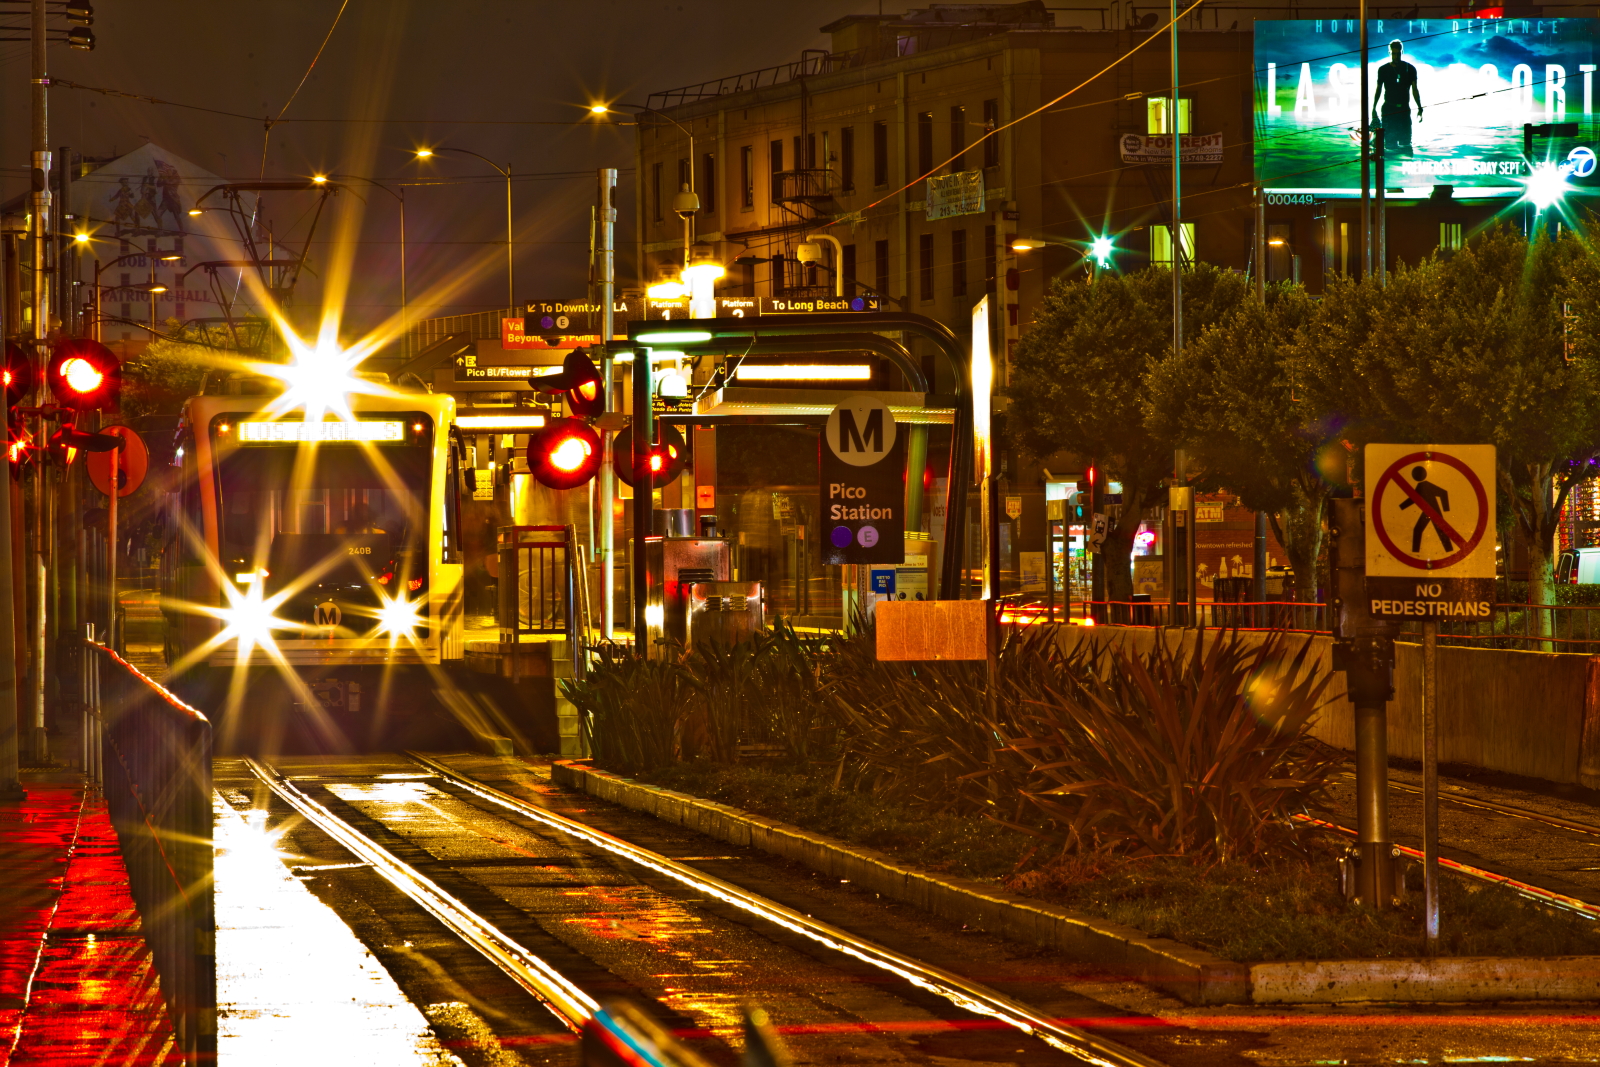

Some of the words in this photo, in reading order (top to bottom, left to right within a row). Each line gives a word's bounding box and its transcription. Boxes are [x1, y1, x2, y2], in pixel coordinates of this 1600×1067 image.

[1315, 19, 1384, 33] HONR
[1409, 20, 1428, 34] IN
[1452, 20, 1558, 34] DEFIANCE
[1267, 62, 1350, 118] LAS
[1180, 135, 1222, 148] RENT
[1179, 154, 1223, 162] 13-749-2227
[1498, 161, 1520, 175] SEPT
[1267, 194, 1313, 205] 000449
[117, 256, 147, 267] BOB
[101, 290, 173, 302] PATRIOIC
[175, 290, 211, 302] HALL
[540, 303, 553, 313] To
[613, 302, 628, 312] LA
[651, 300, 683, 309] Platform
[722, 299, 754, 308] Platform
[772, 301, 786, 311] To
[788, 300, 814, 312] Long
[816, 299, 849, 310] Beach
[661, 309, 671, 320] 1
[466, 368, 485, 376] Pico
[487, 367, 531, 377] Bl/Flower
[839, 408, 884, 453] M
[829, 483, 867, 499] Pico
[830, 504, 893, 520] Station
[1195, 506, 1222, 519] ATM
[348, 547, 371, 555] 240B
[1225, 541, 1253, 549] refreshed
[1416, 584, 1442, 598] NO
[1371, 599, 1491, 617] PEDESTRIANS
[318, 607, 337, 626] M
